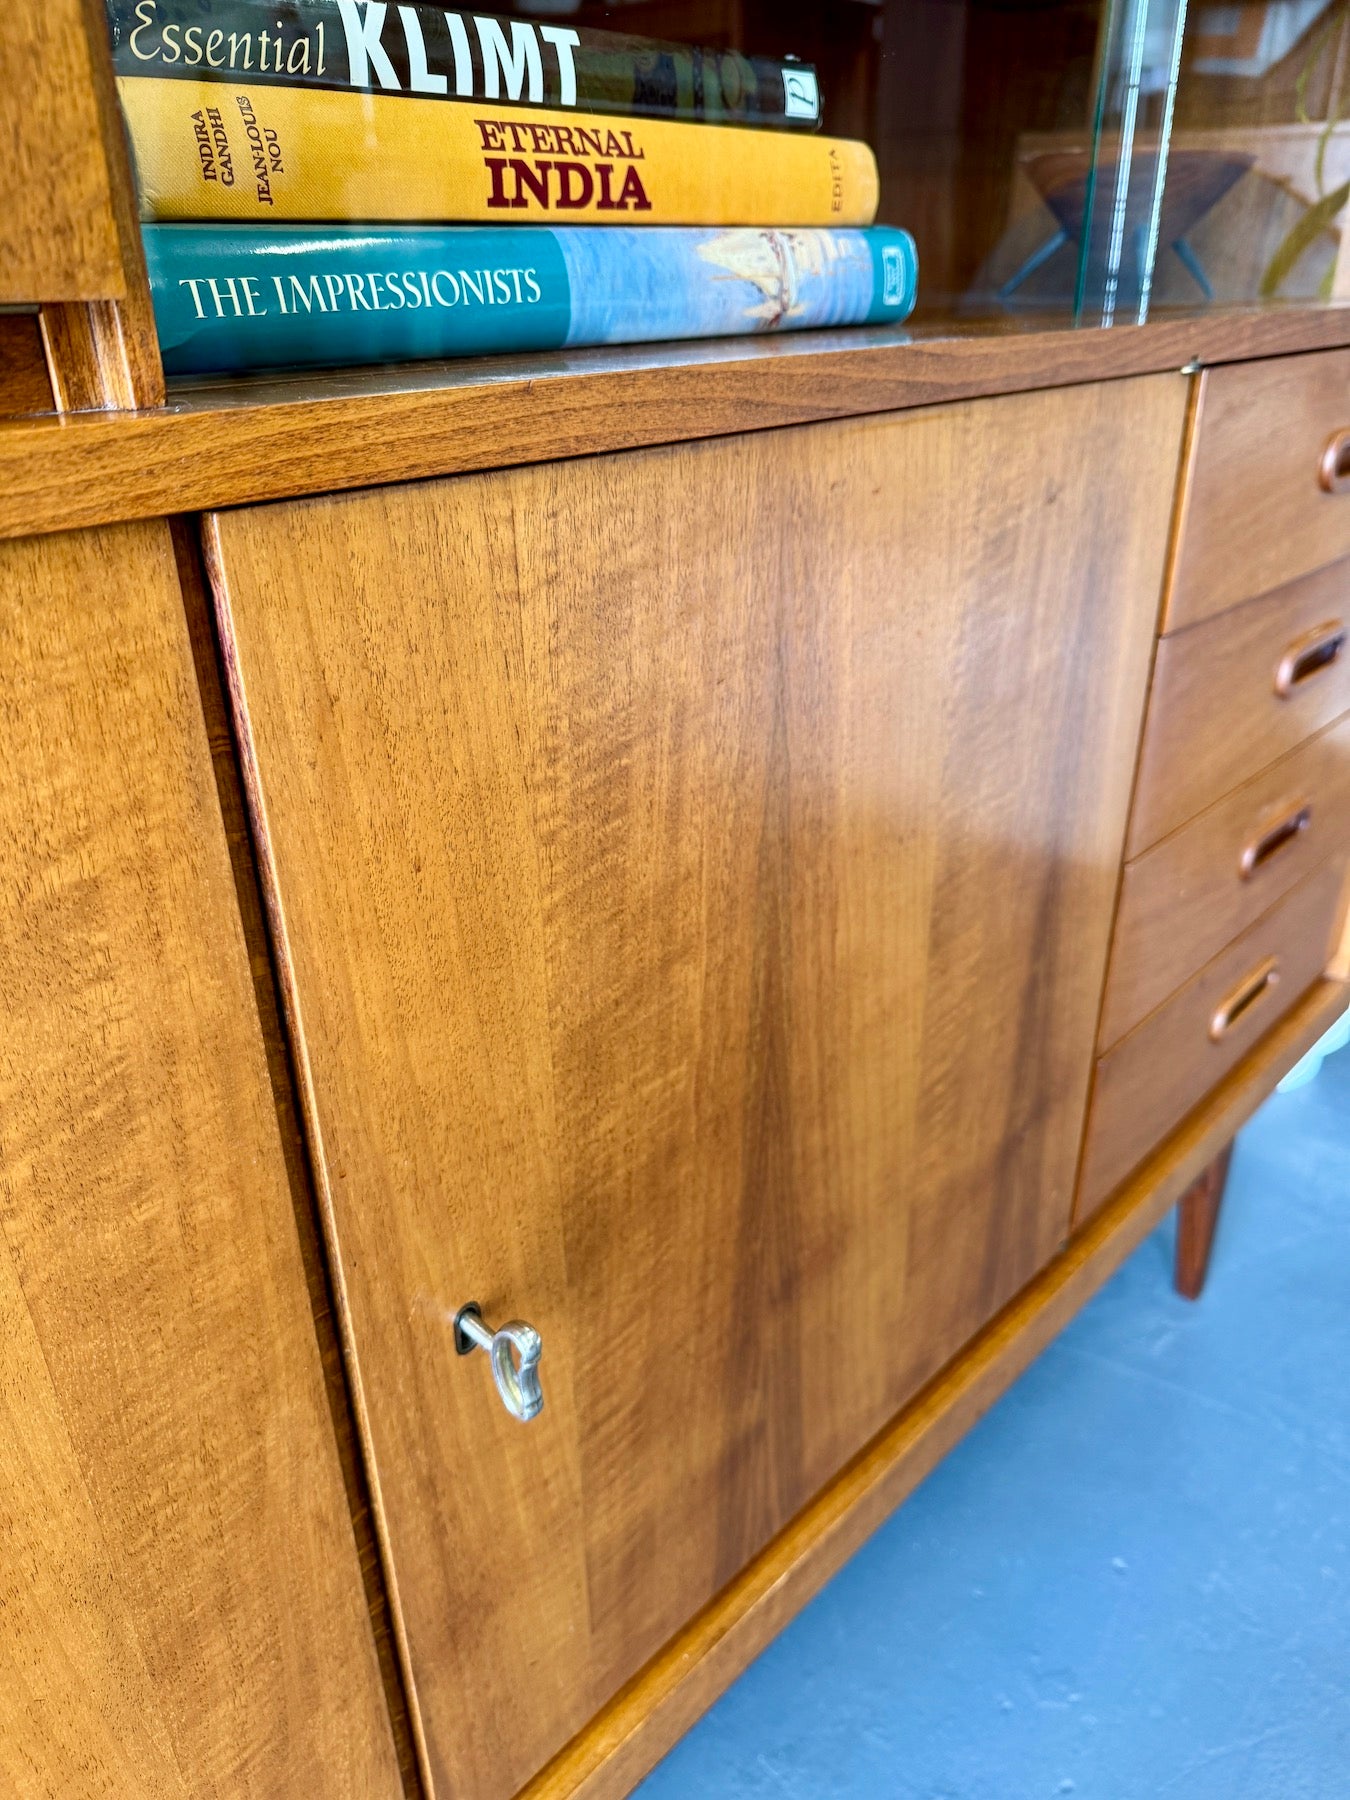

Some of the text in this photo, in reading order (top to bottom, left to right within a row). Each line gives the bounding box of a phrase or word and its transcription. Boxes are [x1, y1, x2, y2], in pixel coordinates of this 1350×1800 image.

[130, 0, 581, 106] Essential KLIMT
[190, 109, 218, 182] INDIRA
[206, 106, 235, 187] GANDHI
[236, 95, 274, 207] JEAN-LOUIS
[263, 127, 284, 174] NOU
[474, 119, 646, 160] ETERNAL
[484, 157, 652, 211] INDIA
[179, 268, 542, 319] THE IMPRESSIONISTS
